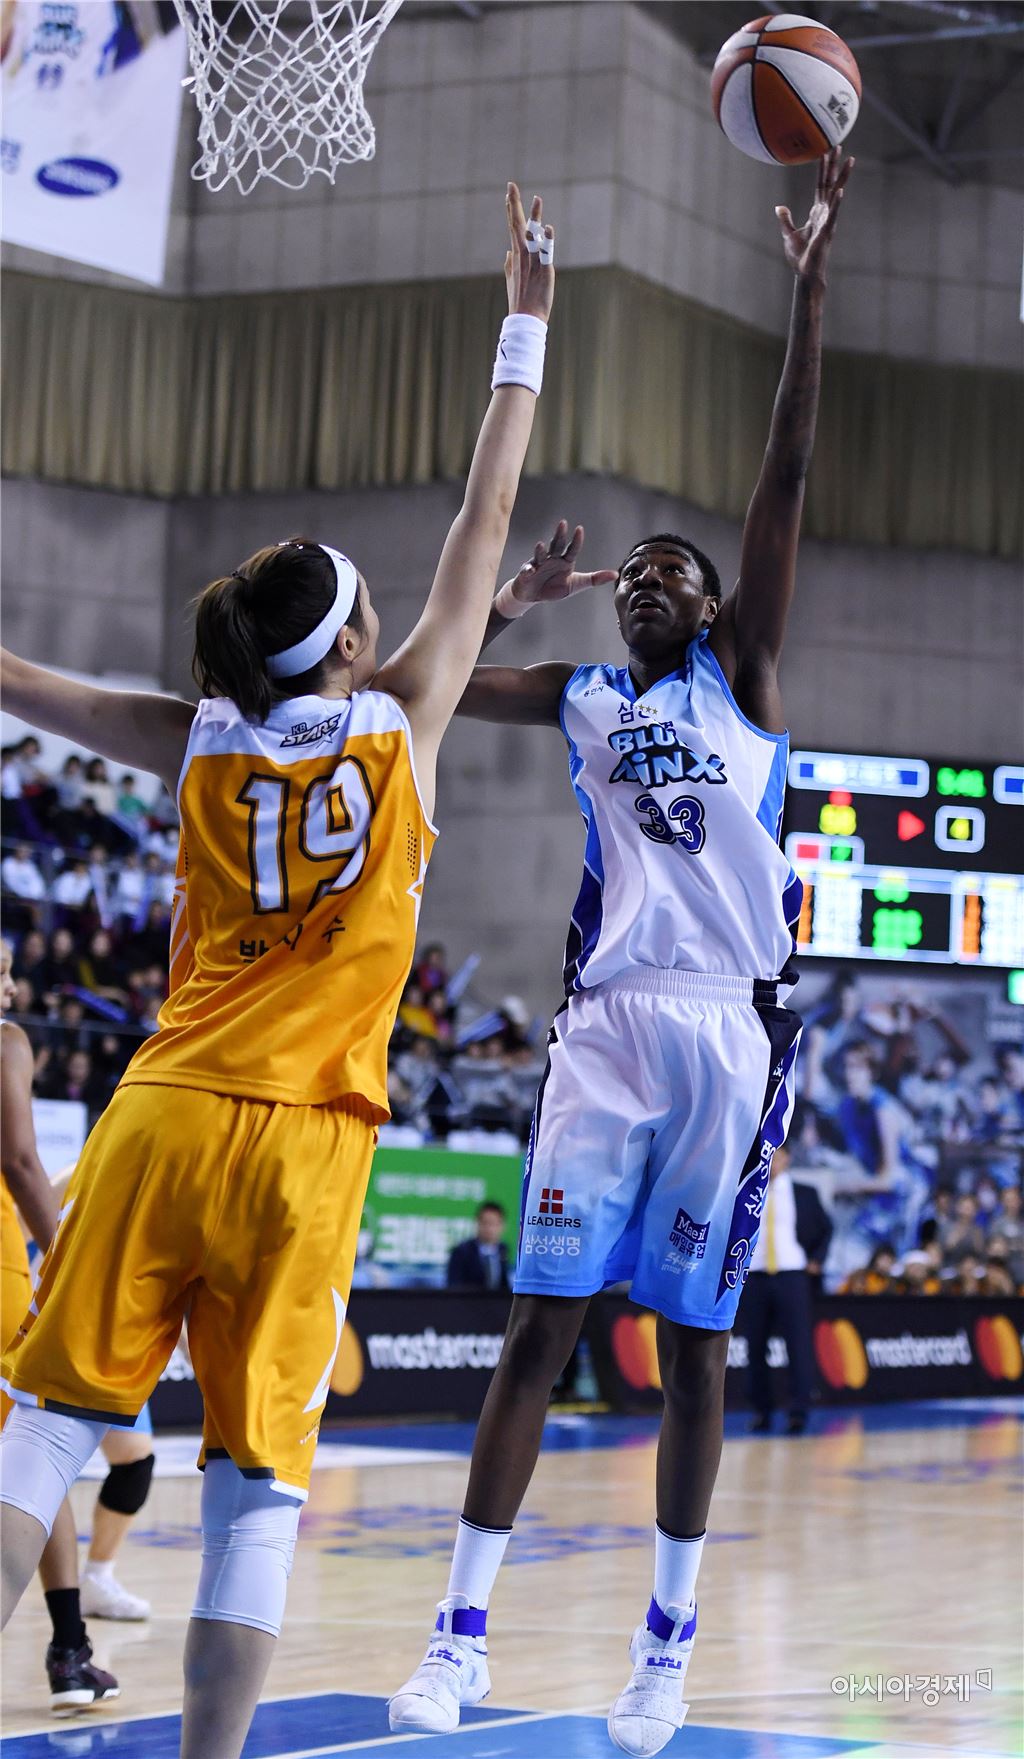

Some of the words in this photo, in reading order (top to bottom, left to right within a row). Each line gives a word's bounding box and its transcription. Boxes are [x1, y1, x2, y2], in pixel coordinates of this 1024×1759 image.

[280, 713, 342, 747] STARS
[292, 722, 307, 735] KB
[608, 724, 682, 757] BLU
[235, 755, 376, 914] 19
[634, 794, 706, 855] 33
[527, 1216, 582, 1229] LEADERS
[677, 1216, 707, 1241] Maeil
[524, 1234, 581, 1257] 삼성생명
[669, 1231, 706, 1259] 매일유업
[725, 1238, 757, 1290] 3
[366, 1327, 504, 1369] masterca
[866, 1329, 972, 1367] mastercard
